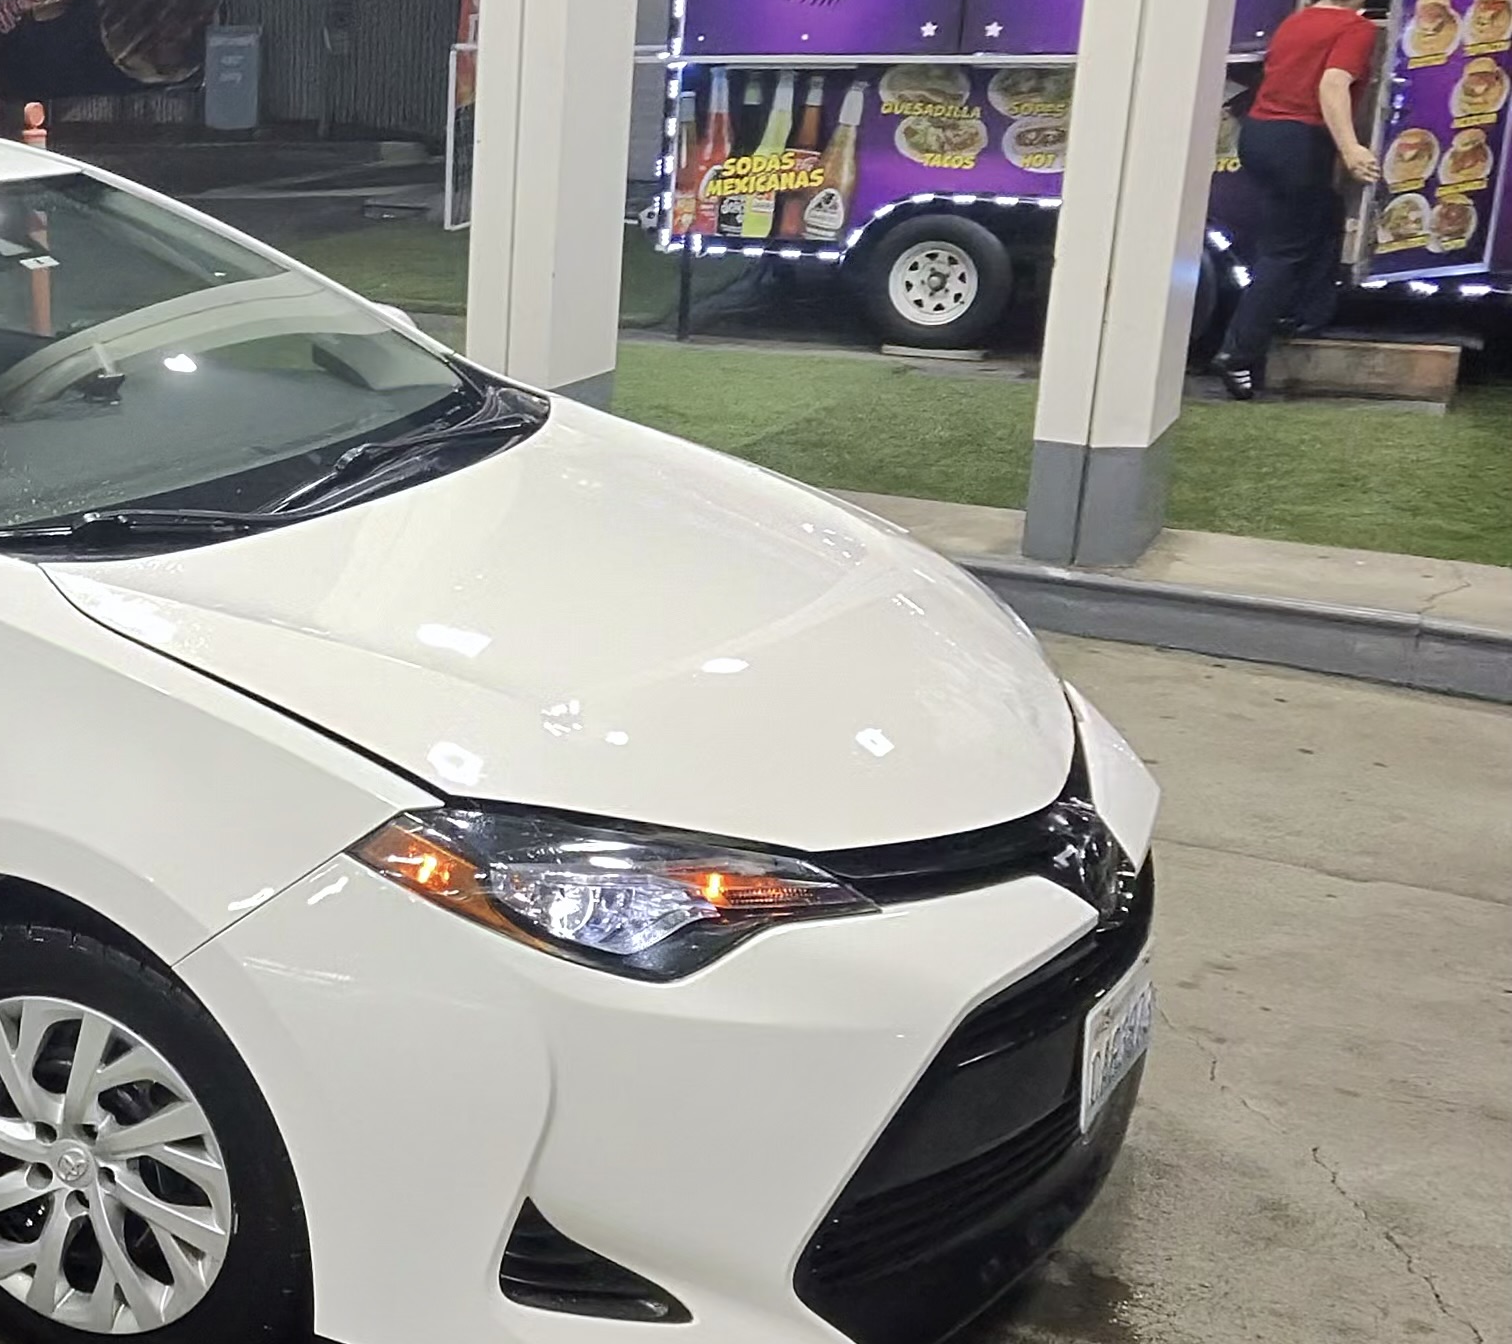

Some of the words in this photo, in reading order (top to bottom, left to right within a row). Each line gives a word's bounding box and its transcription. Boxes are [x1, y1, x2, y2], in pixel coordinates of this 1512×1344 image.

[880, 100, 982, 119] QUESADILLA
[721, 152, 796, 177] SODAS
[922, 152, 977, 171] TACOS
[1020, 153, 1057, 170] HOT
[705, 167, 826, 198] MEXICANAS
